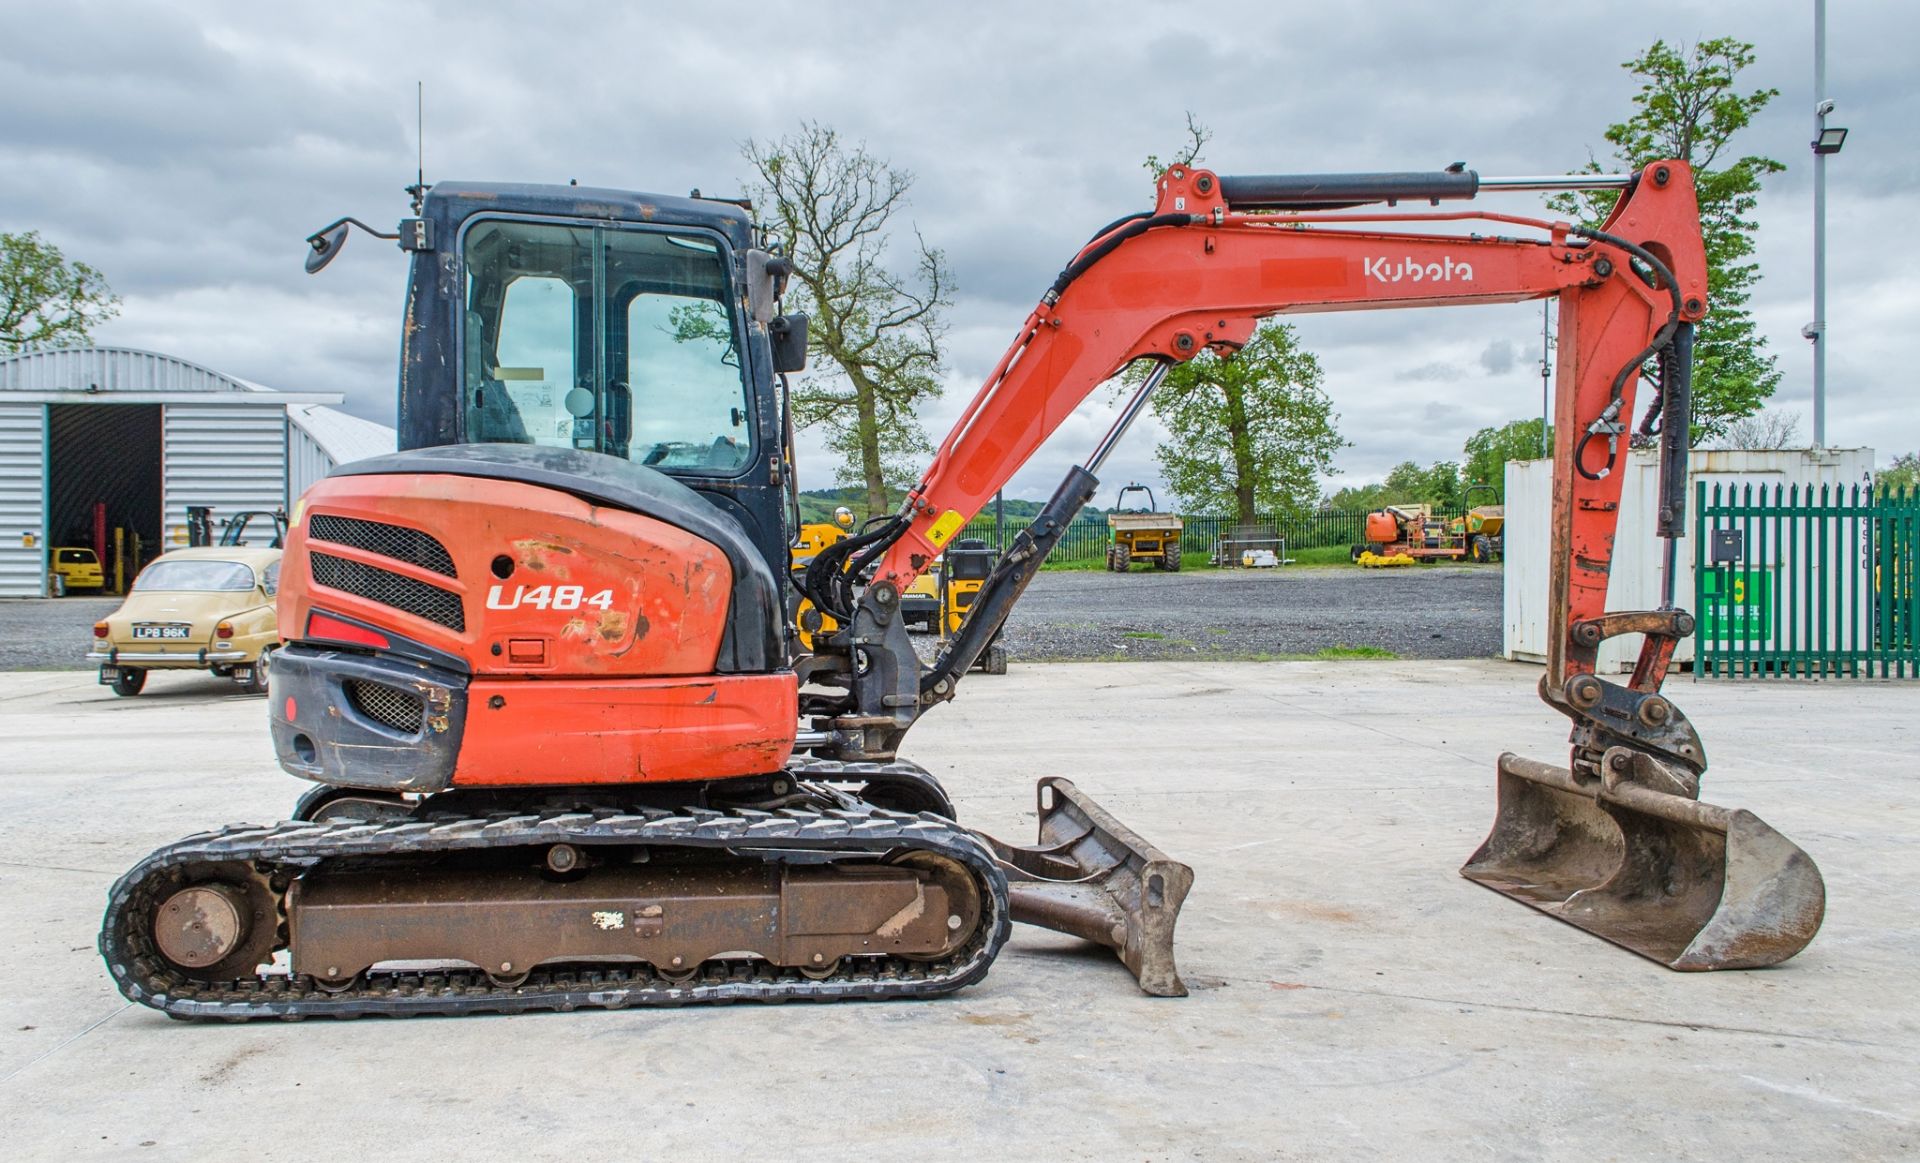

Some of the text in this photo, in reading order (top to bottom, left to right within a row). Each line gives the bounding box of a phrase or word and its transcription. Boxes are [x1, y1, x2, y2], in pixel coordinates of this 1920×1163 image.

[1364, 256, 1473, 282] Kubota
[486, 585, 613, 610] U48-4
[137, 628, 187, 638] LPB 96K
